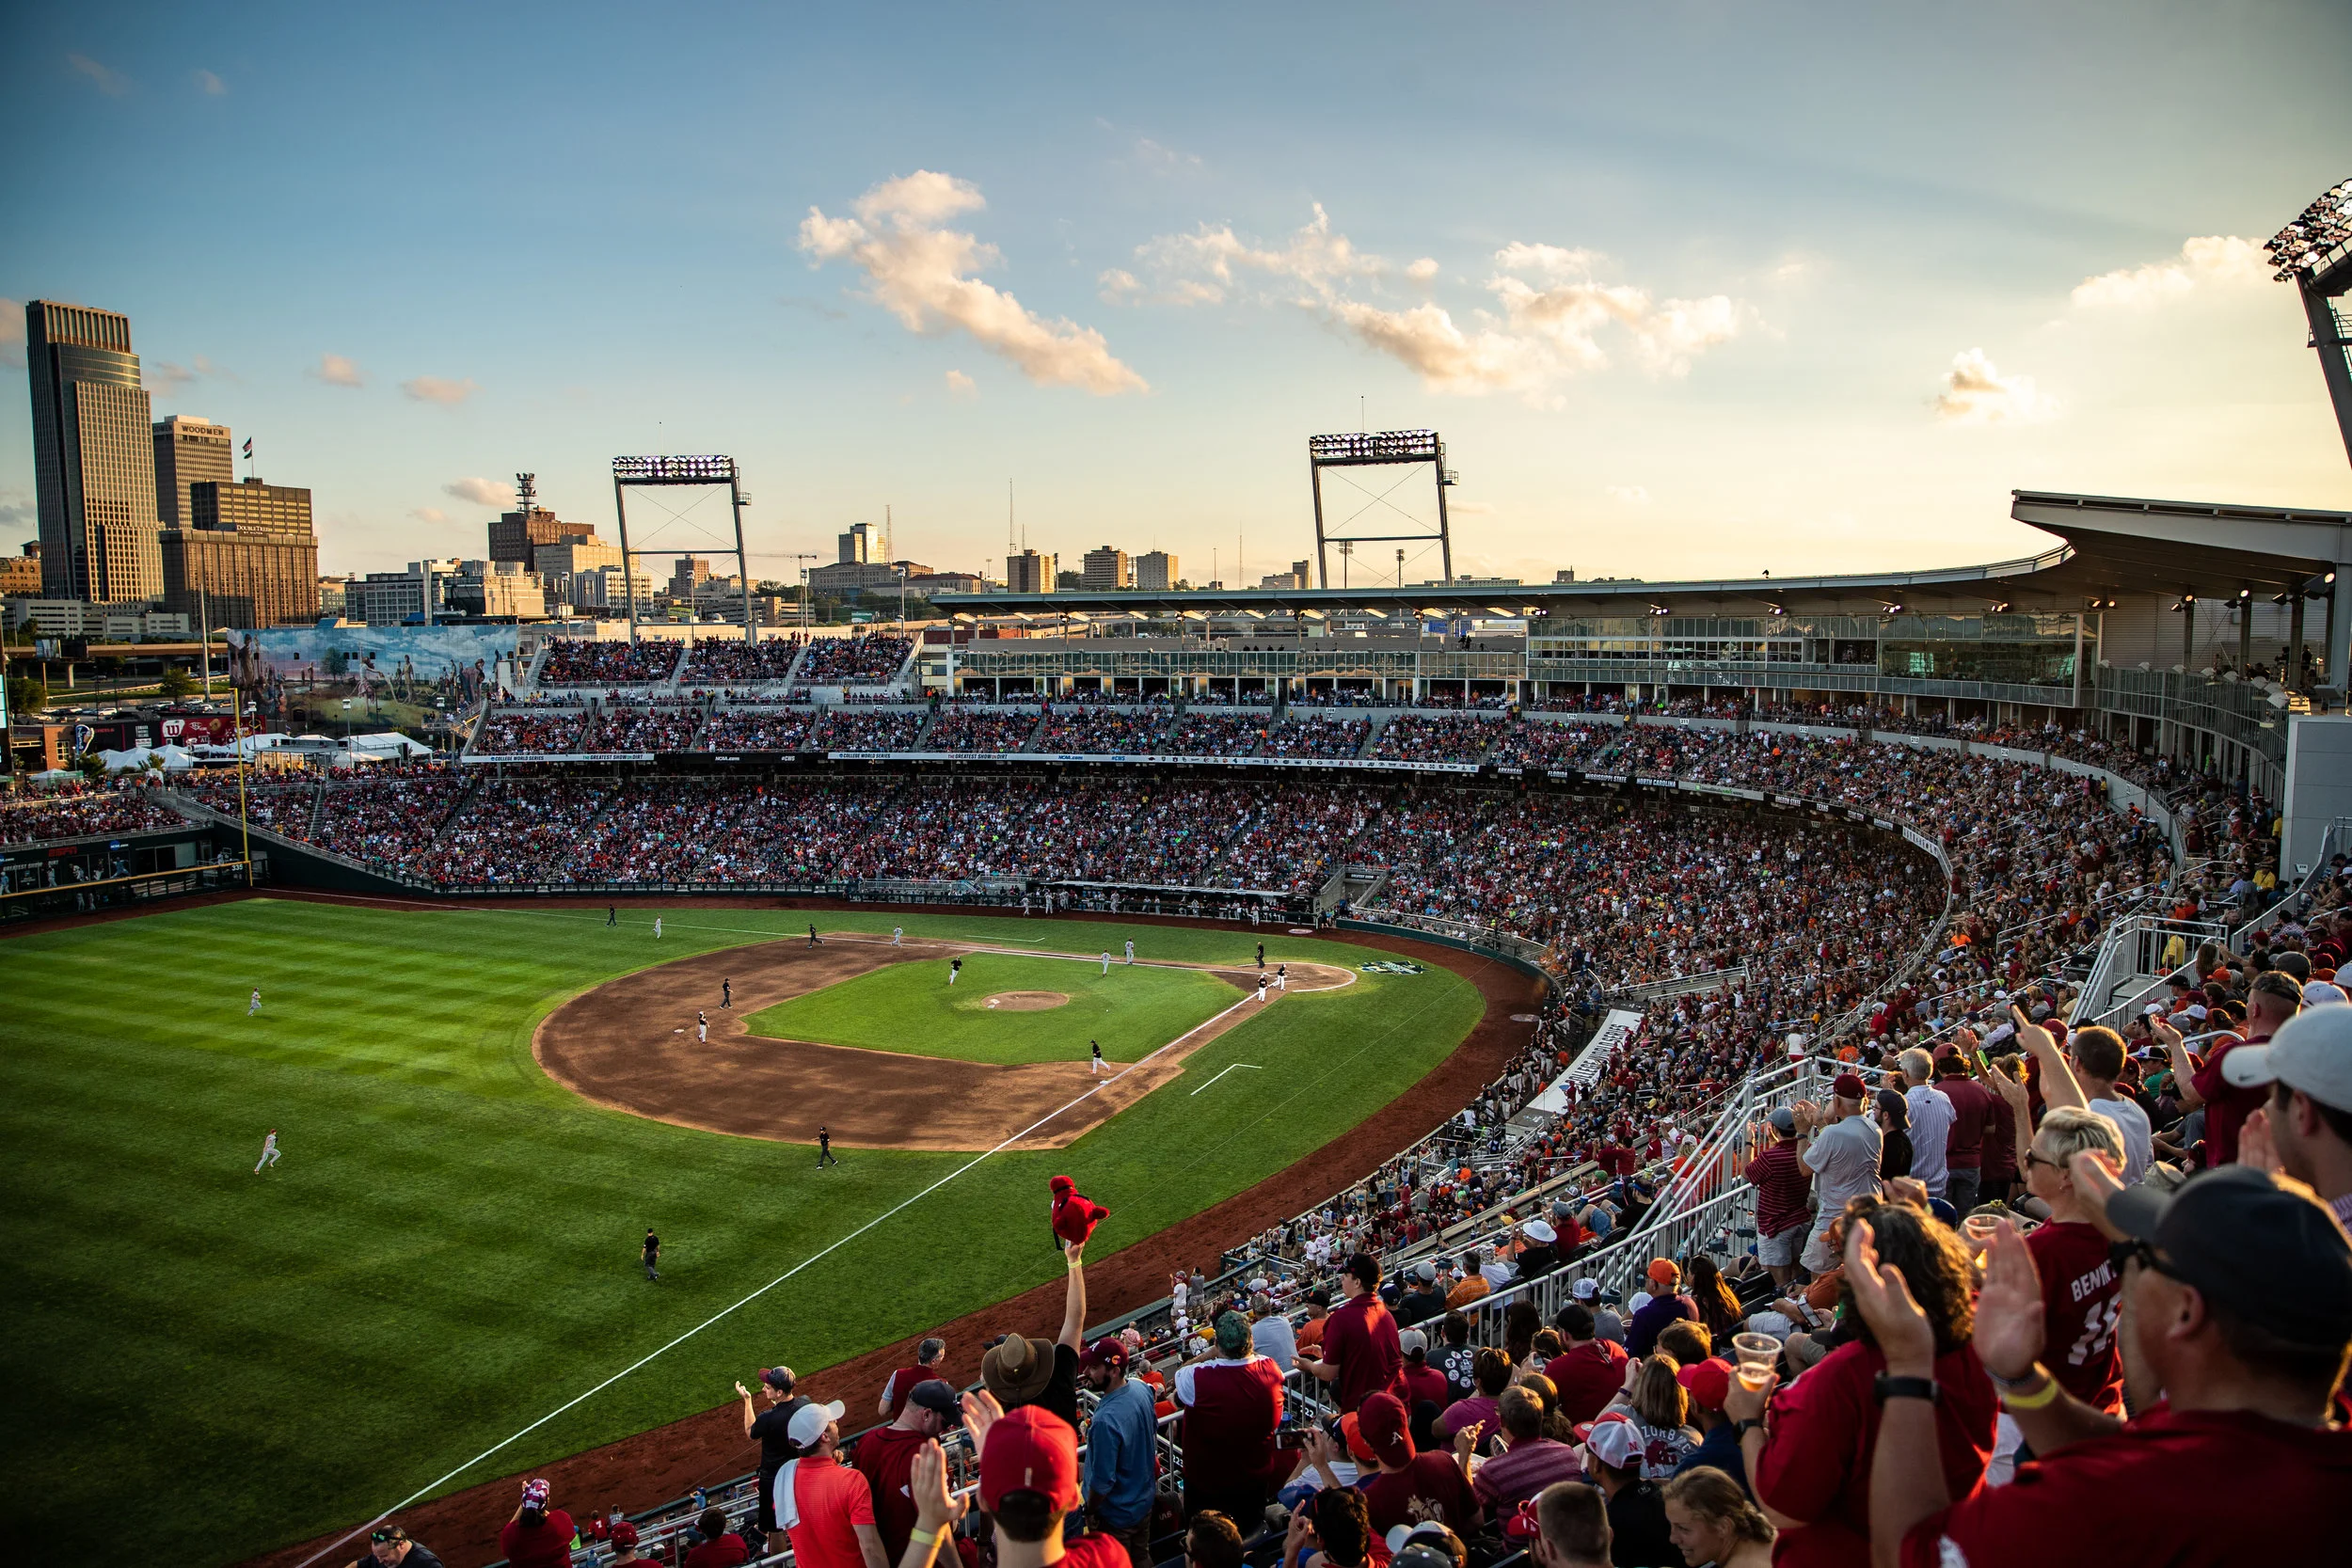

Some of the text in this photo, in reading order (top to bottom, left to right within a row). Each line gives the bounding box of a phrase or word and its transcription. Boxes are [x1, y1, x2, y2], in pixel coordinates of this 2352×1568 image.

[182, 425, 223, 436] WOODMEN
[167, 725, 180, 736] W
[1498, 767, 1523, 775] ARKANSAS
[1585, 772, 1628, 784] MISSISSIPPI STATE
[1636, 778, 1677, 787] NORTH CAROLINA
[1789, 798, 1802, 807] STATE
[1816, 802, 1829, 812] TEXAS
[48, 846, 78, 857] ESPN
[1391, 1432, 1403, 1446] A
[1628, 1441, 1639, 1451] N
[596, 1519, 602, 1528] 7
